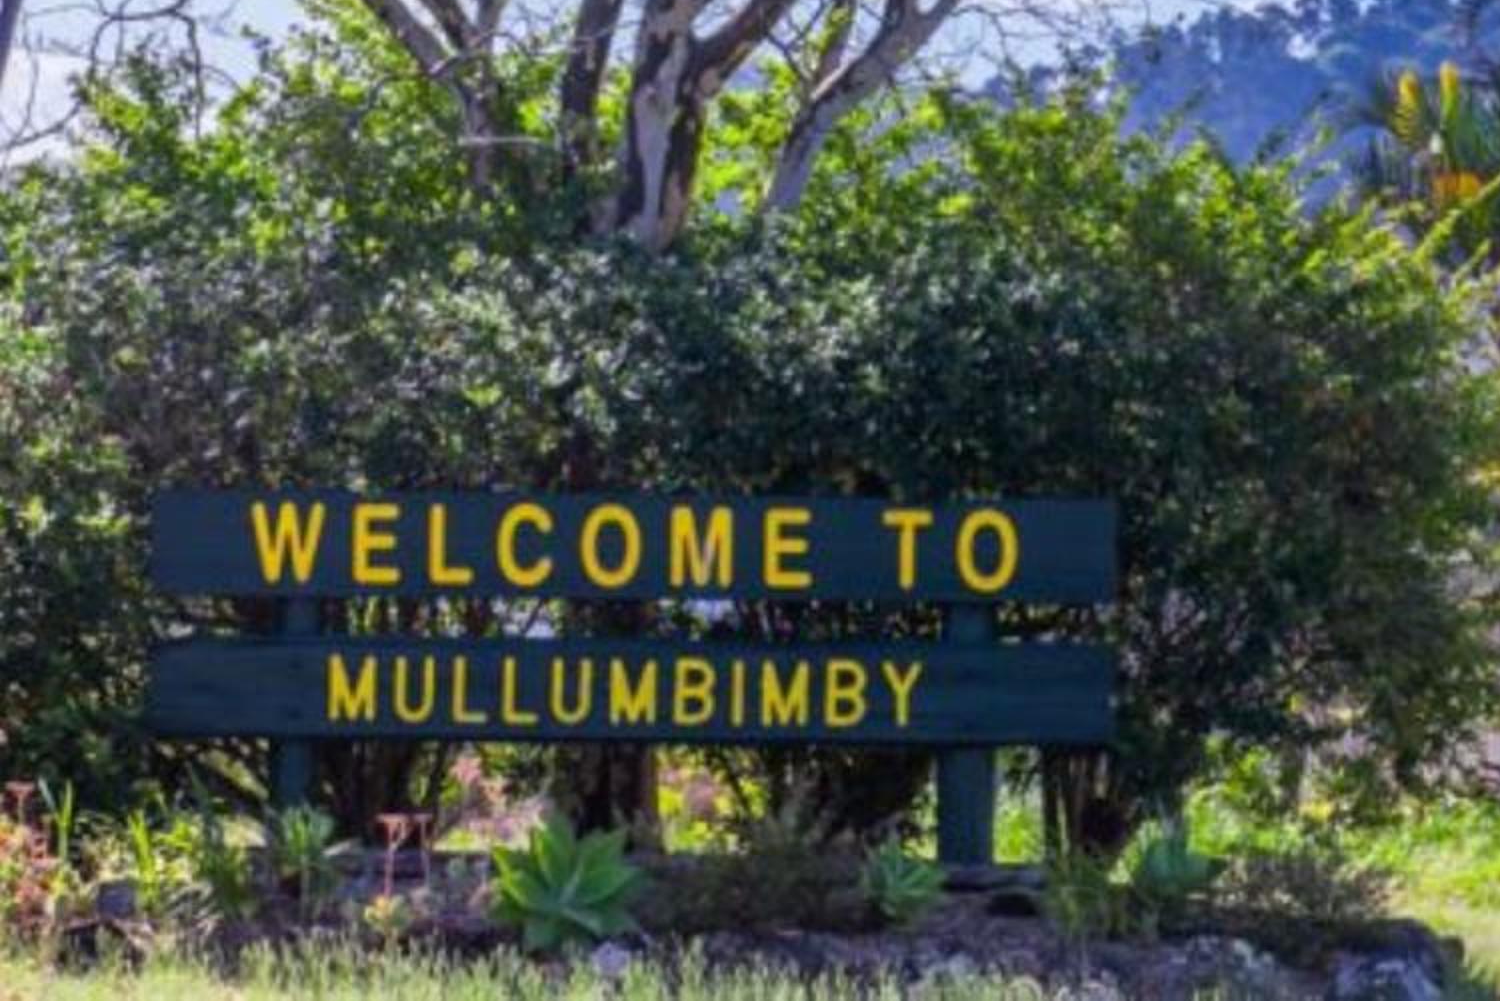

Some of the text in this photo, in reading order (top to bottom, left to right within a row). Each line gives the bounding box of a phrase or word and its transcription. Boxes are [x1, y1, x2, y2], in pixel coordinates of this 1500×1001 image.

[251, 501, 1019, 593] WELCOME TO
[326, 654, 926, 728] MULLUMBIMBY
